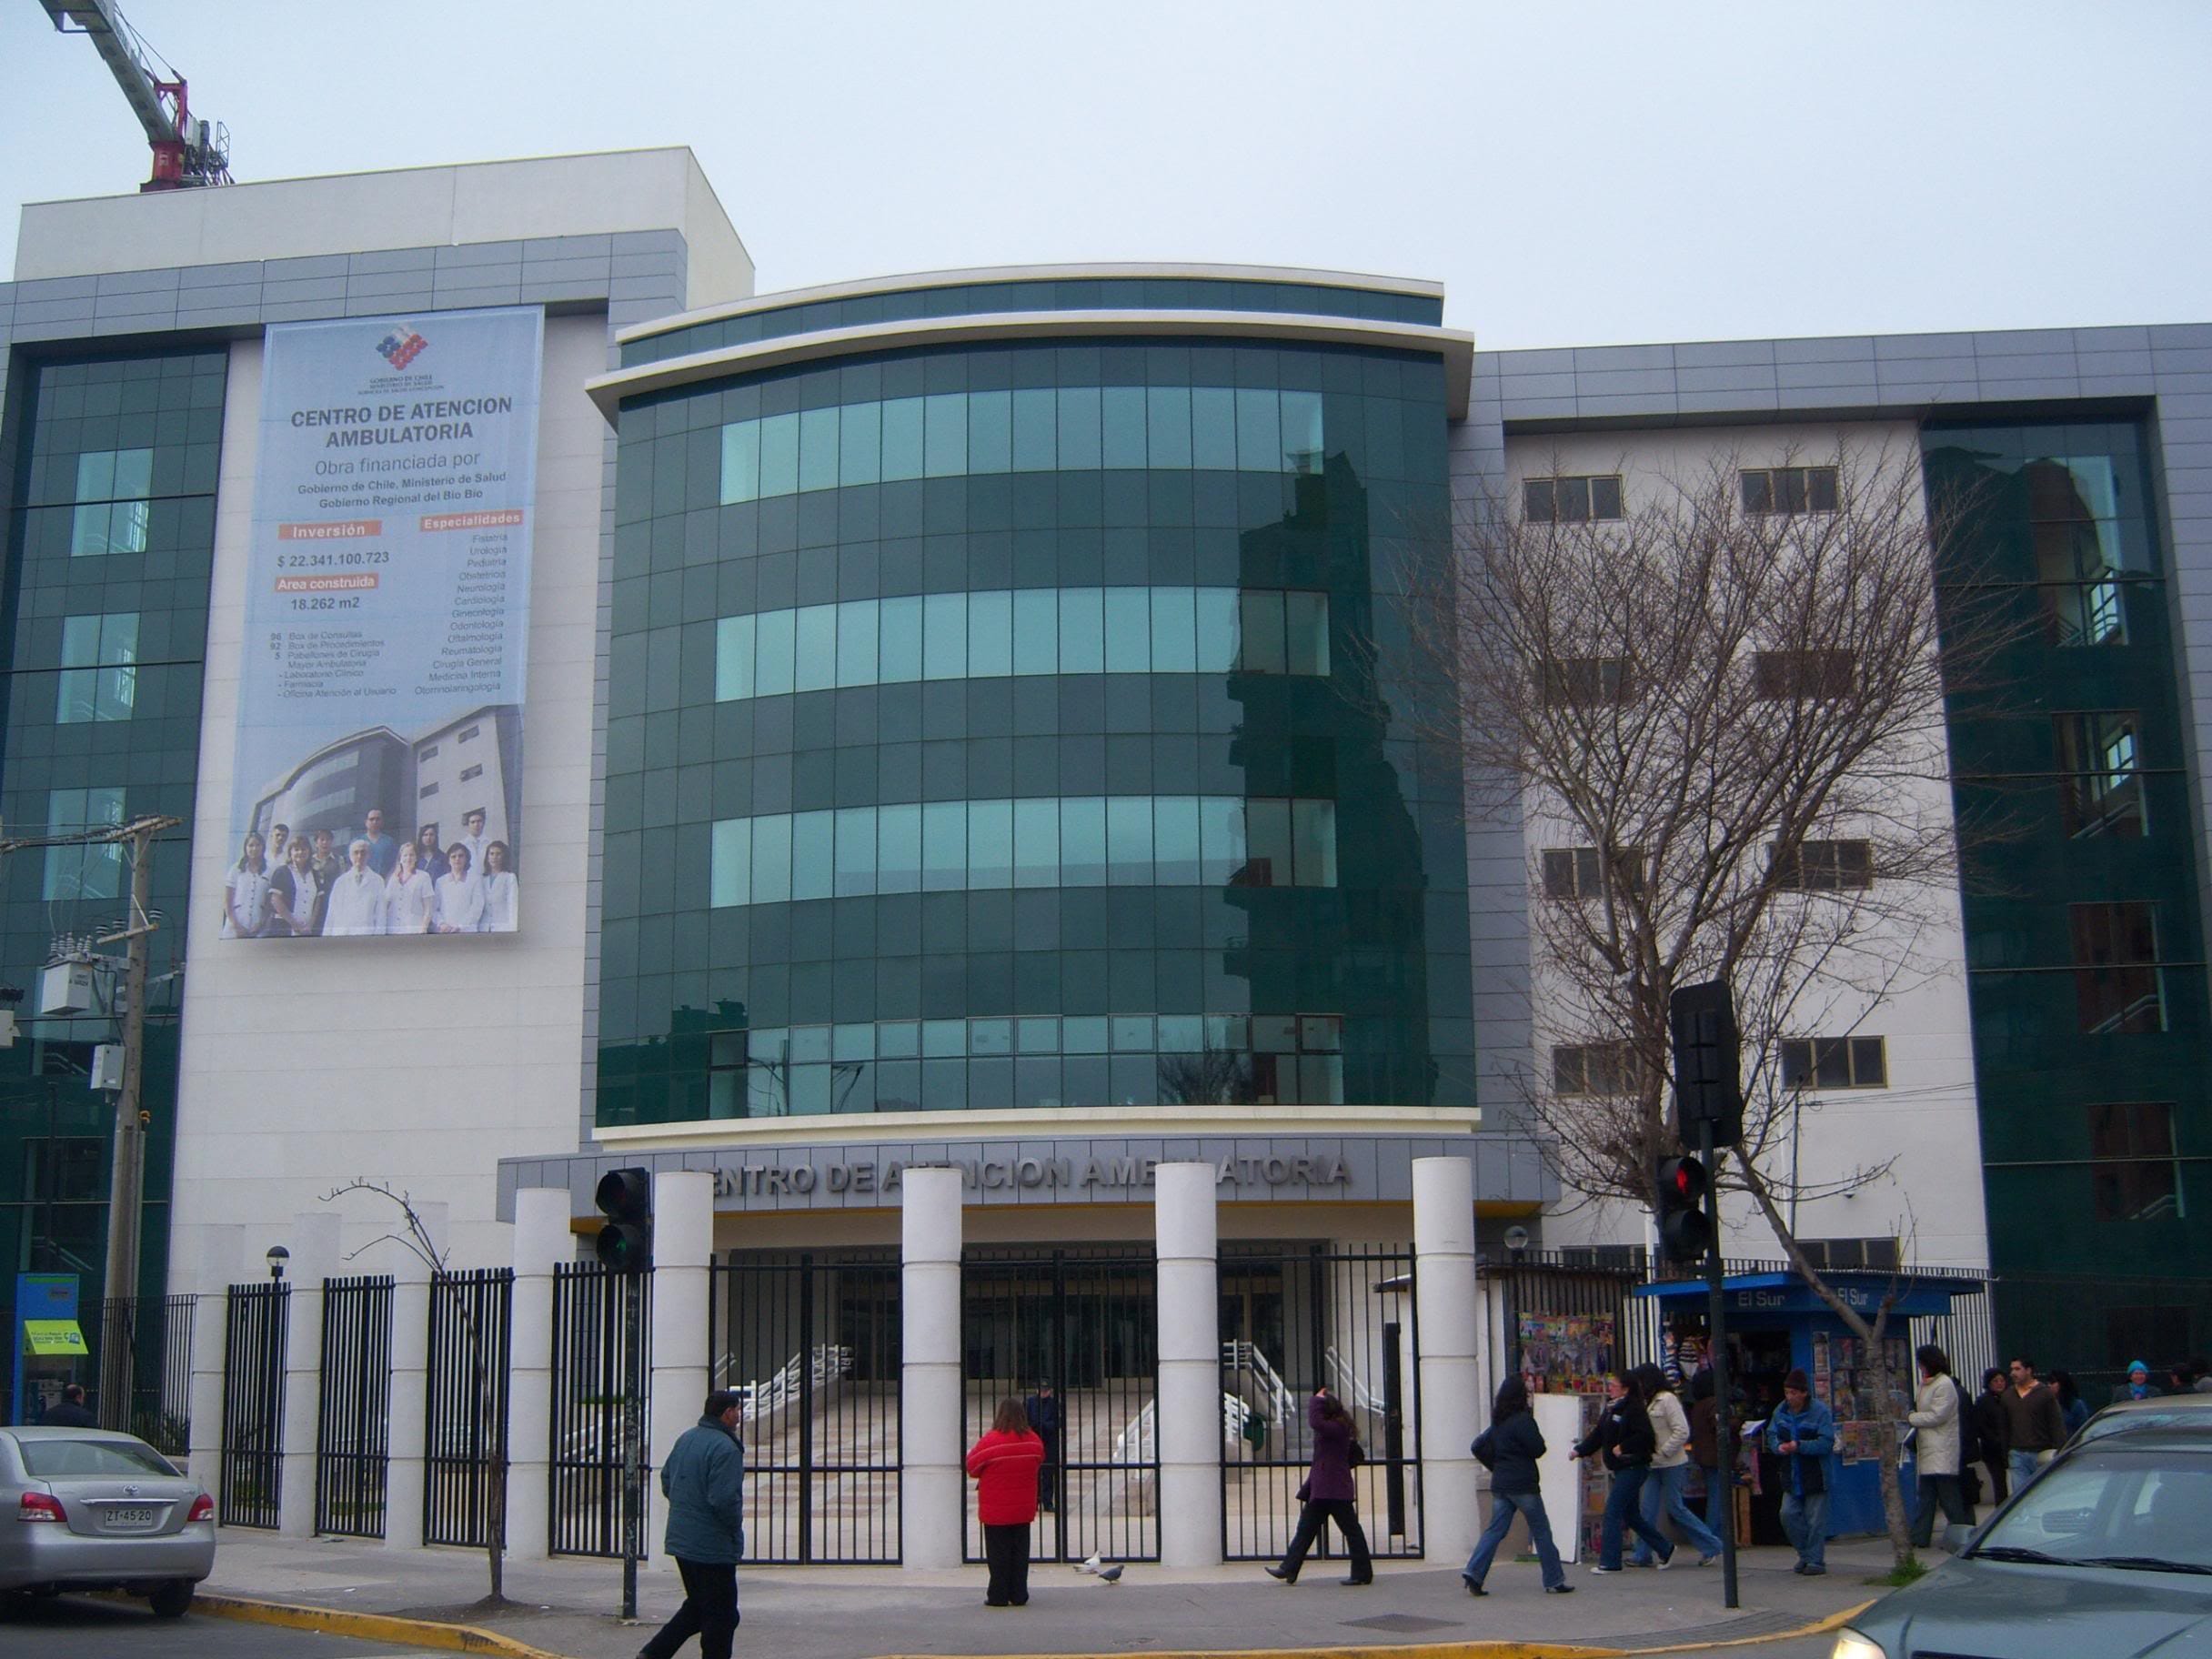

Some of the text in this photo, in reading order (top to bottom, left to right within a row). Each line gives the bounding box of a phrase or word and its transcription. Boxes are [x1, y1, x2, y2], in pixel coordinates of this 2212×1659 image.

[291, 397, 512, 427] CENTRO DE ATENCION
[326, 422, 474, 448] AMBULATORIA
[315, 453, 481, 476] Obra financiada por
[297, 482, 349, 494] Gobierno
[351, 481, 365, 491] de
[401, 476, 455, 488] Ministerio
[457, 474, 472, 484] de
[475, 471, 507, 483] Salud
[319, 497, 370, 508] Gobierno
[373, 492, 420, 507] Regional
[424, 491, 440, 502] del
[424, 513, 521, 530] Especialidades
[293, 524, 366, 538] Inversión
[276, 551, 390, 568] $ 22.341.100.723
[309, 575, 376, 589] construida
[291, 597, 360, 610] 18.262 m2
[682, 1154, 1352, 1197] NTRO DE ANCION AMBATORIA
[1738, 1291, 1785, 1307] El Sur
[1849, 1288, 1868, 1306] Sur
